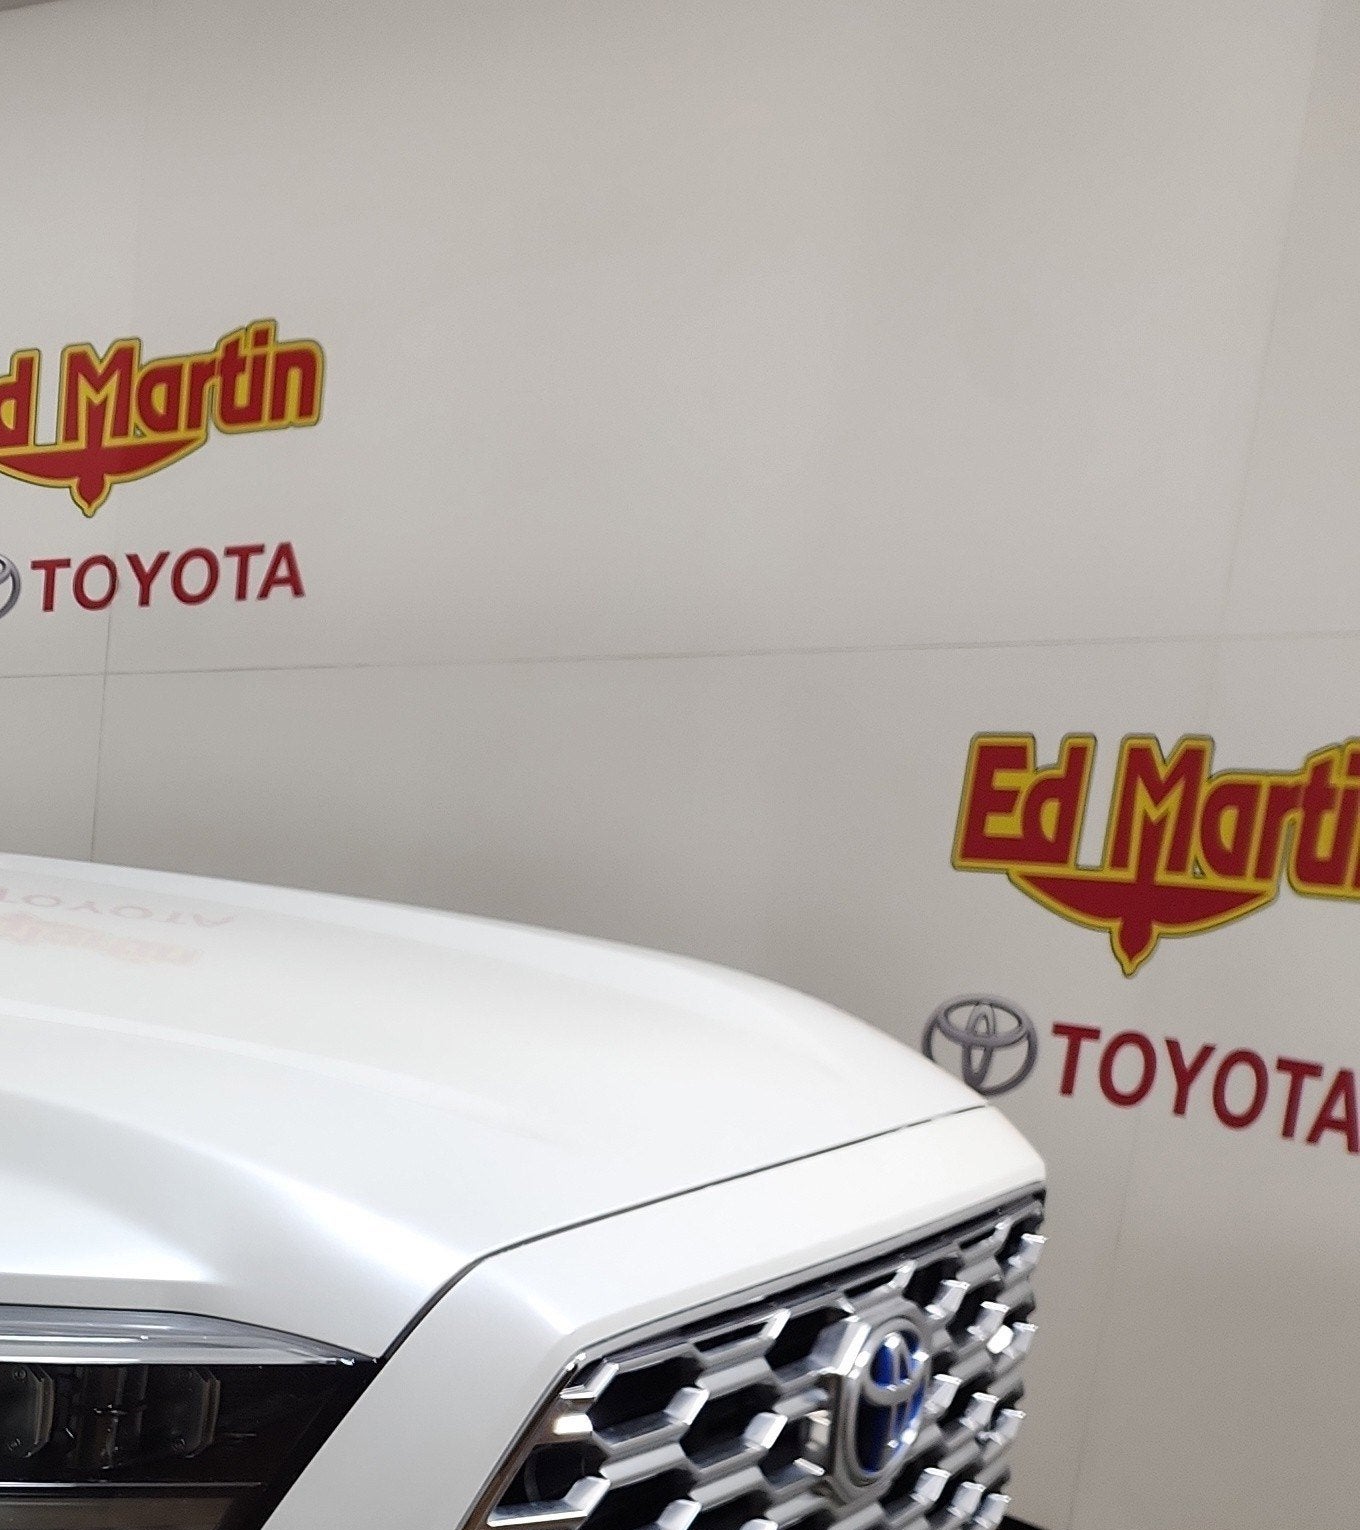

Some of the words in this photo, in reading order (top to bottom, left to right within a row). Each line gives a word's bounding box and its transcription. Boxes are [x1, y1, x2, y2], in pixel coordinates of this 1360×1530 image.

[56, 319, 325, 448] Martin
[30, 541, 306, 613] TOYOTA
[951, 732, 1097, 873] Ed
[1104, 733, 1360, 905] Marti
[1052, 1022, 1360, 1155] TOYOTA
